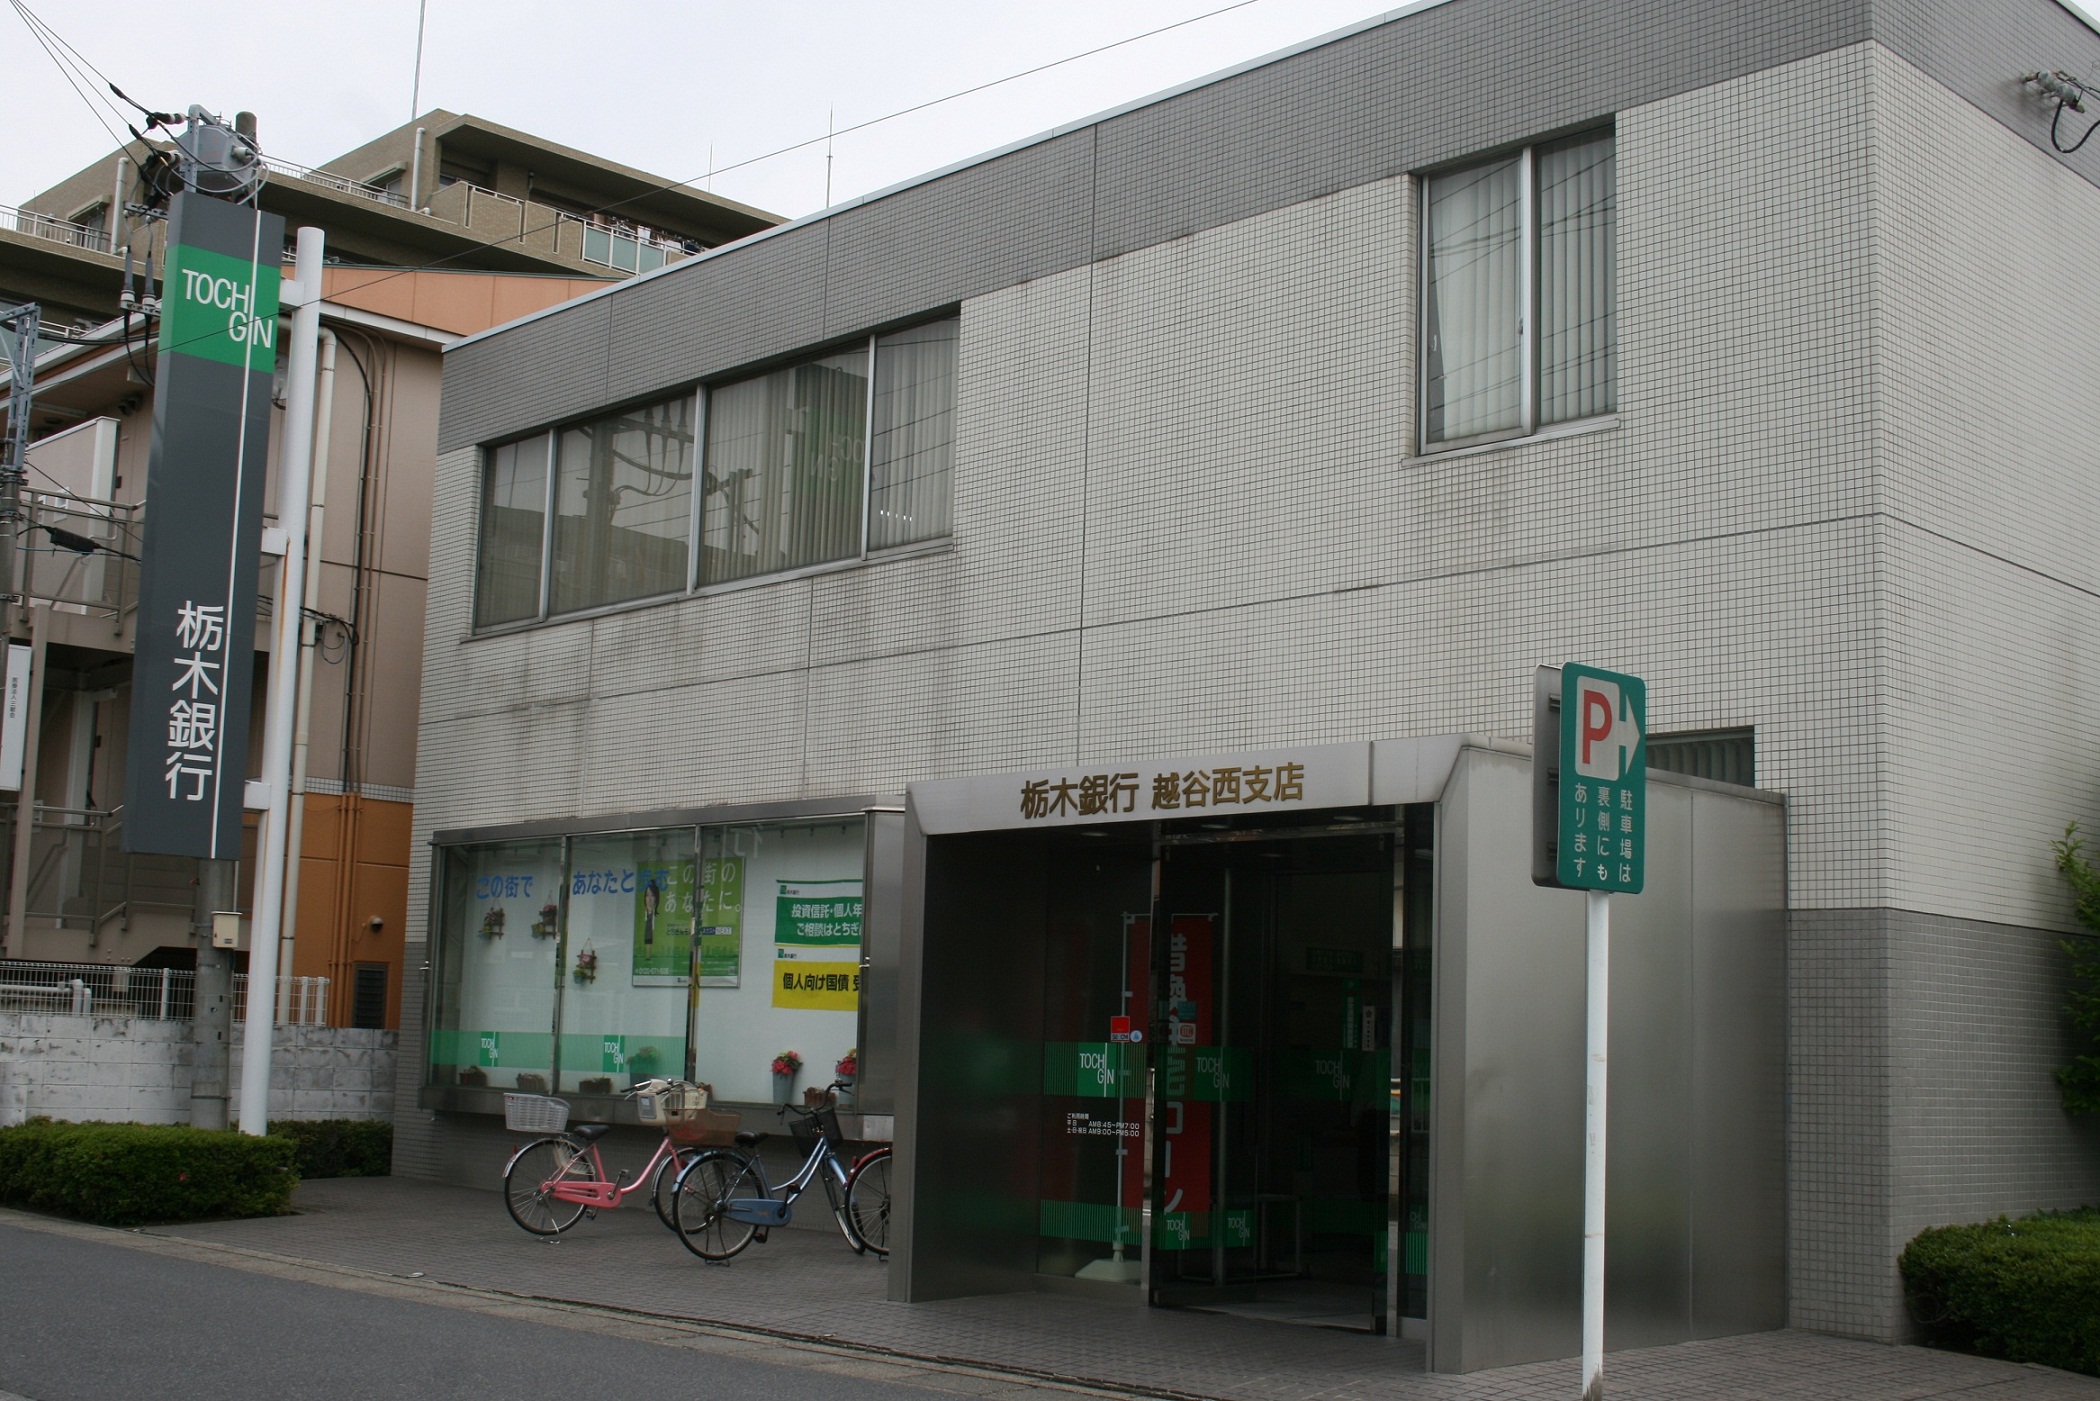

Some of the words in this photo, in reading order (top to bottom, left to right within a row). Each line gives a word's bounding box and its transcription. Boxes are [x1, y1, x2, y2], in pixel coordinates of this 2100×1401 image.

[165, 600, 224, 801] 栃木銀行
[1582, 689, 1613, 765] P
[1020, 772, 1140, 820] 栃木銀行
[1151, 761, 1305, 811] 越谷西支店
[1573, 782, 1588, 878] あります
[1596, 786, 1611, 881] 裏側にも
[1618, 788, 1633, 884] 駐車場は
[476, 874, 533, 899] この街で
[572, 868, 670, 896] あなたと歩む
[797, 922, 861, 936] ご相談はとちぎ
[783, 972, 849, 991] 個人向け国債
